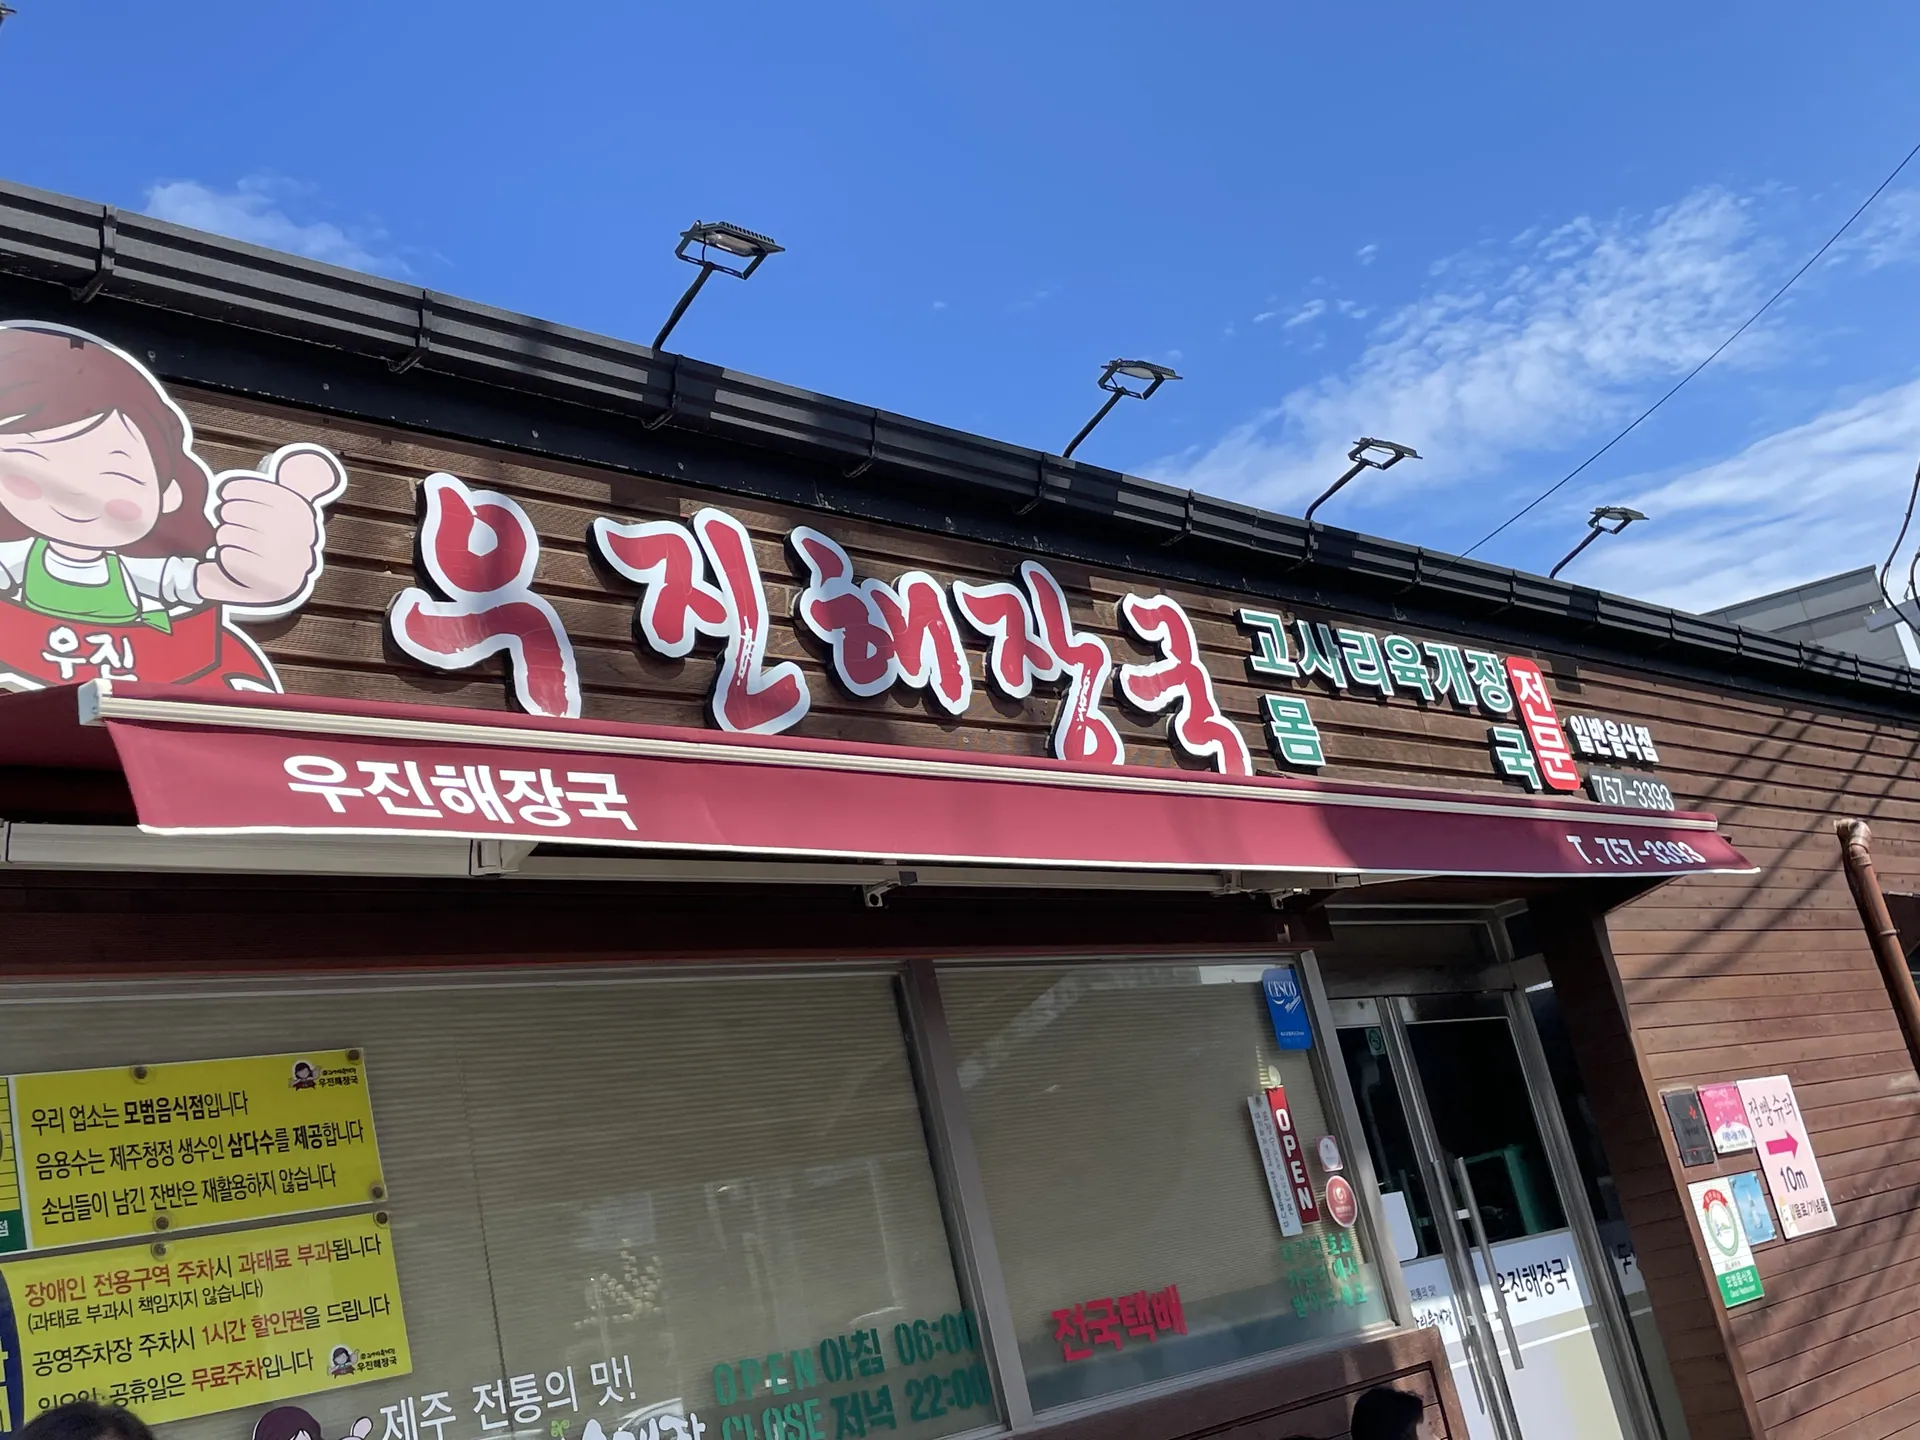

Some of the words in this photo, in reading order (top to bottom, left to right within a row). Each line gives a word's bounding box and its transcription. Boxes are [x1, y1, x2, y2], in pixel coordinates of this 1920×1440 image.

[43, 627, 137, 681] 우진
[392, 470, 1254, 777] 우진해장국
[1237, 607, 1513, 714] 고사리육개장
[1265, 693, 1327, 768] 몸
[1492, 726, 1543, 791] 국
[1511, 668, 1577, 783] 전문
[1569, 713, 1660, 763] 일반음식점
[283, 755, 638, 831] 우진해장국
[1592, 775, 1675, 811] 757-3393
[31, 1107, 65, 1136] 우리
[69, 1103, 119, 1132] 업소는
[124, 1090, 248, 1126] 모범음식점입니다
[36, 1148, 105, 1180] 음용수는
[109, 1140, 174, 1169] 제주청정
[179, 1134, 225, 1164] 생수인
[227, 1128, 290, 1158] 삼다수를
[293, 1119, 364, 1149] 제공합니다
[42, 1191, 109, 1225] 손님들이
[112, 1185, 146, 1216] 남긴
[150, 1181, 198, 1211] 잔반은
[201, 1169, 275, 1204] 재활용하지
[279, 1162, 336, 1195] 않습니다
[1275, 1108, 1313, 1210] OPEN
[1780, 1165, 1808, 1193] 10m
[25, 1275, 87, 1307] 장애인
[93, 1263, 171, 1295] 전용구역
[177, 1255, 233, 1286] 주차시
[238, 1247, 293, 1275] 과태료
[296, 1233, 382, 1267] 부과됩니다
[27, 1306, 82, 1335] (과태료
[86, 1295, 133, 1323] 부과시
[138, 1287, 199, 1316] 책임지지
[201, 1279, 265, 1305] 않습니다)
[32, 1336, 132, 1376] 공영주차장
[138, 1330, 196, 1360] 주차시
[201, 1319, 247, 1347] 1시간
[252, 1304, 321, 1339] 할인권을
[326, 1293, 391, 1325] 드립니다
[712, 1347, 817, 1406] OPEN
[819, 1328, 886, 1383] 아침
[894, 1310, 978, 1366] 06:00
[1051, 1284, 1187, 1362] 전국택배
[191, 1349, 314, 1393] 무료주차입니다
[379, 1390, 457, 1440] 제주
[473, 1366, 579, 1427] 전통의
[590, 1354, 637, 1408] 맛!
[830, 1385, 897, 1440] 저녁
[905, 1364, 990, 1421] 22:00
